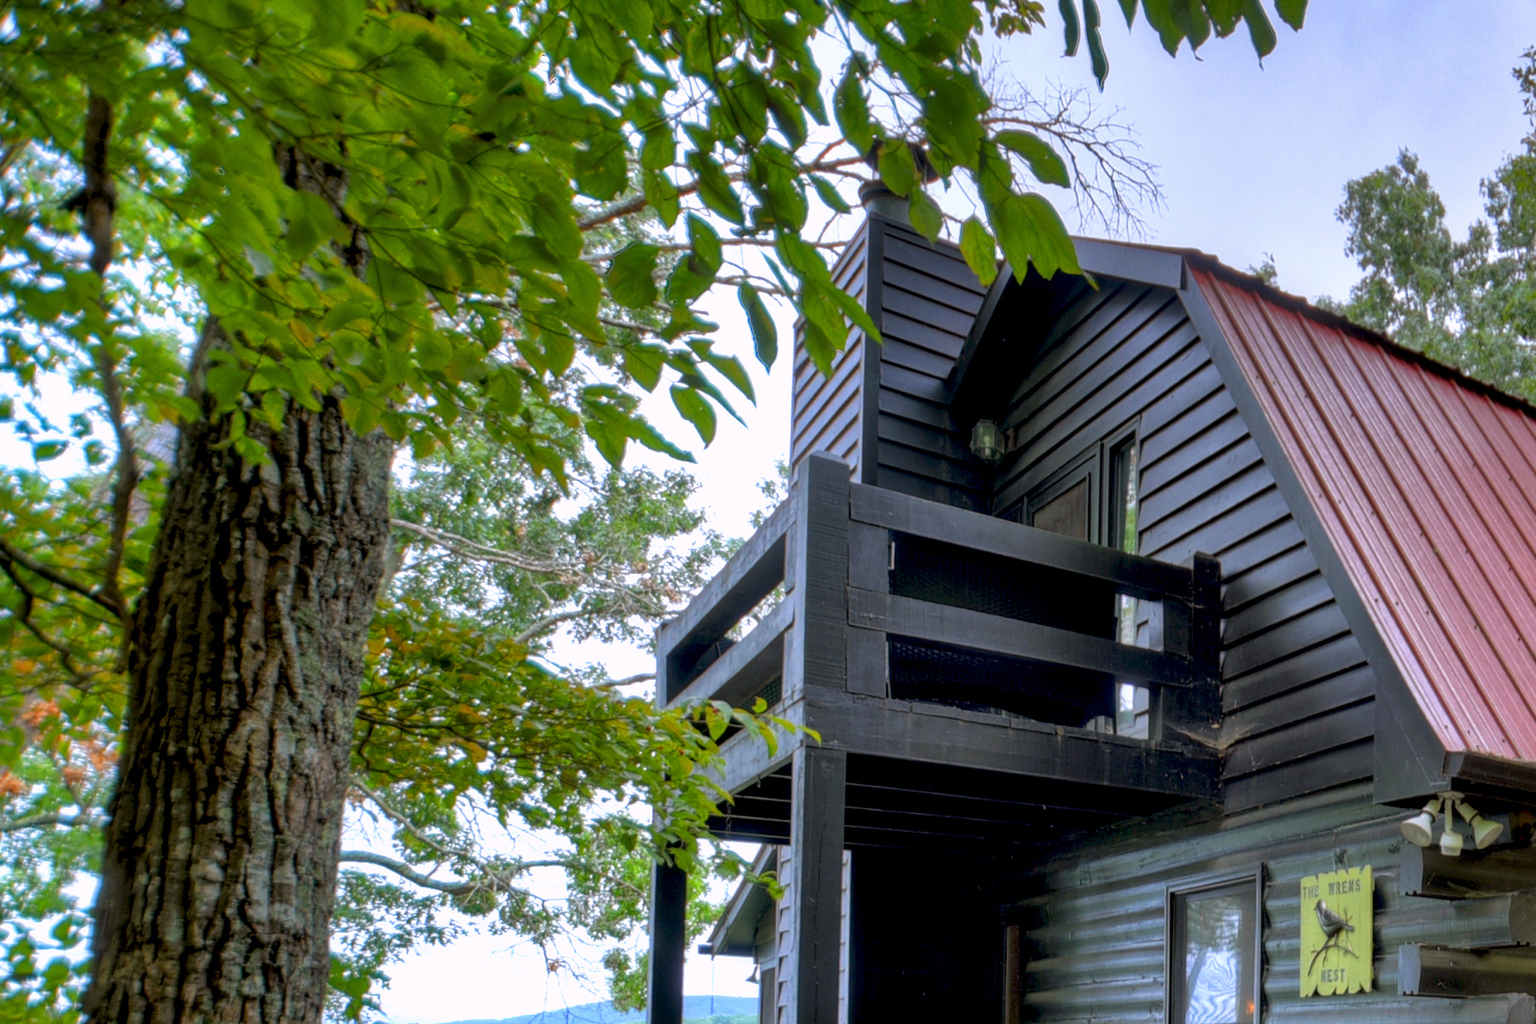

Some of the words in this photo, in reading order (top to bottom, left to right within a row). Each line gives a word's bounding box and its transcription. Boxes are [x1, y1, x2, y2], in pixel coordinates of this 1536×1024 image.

[1303, 886, 1319, 899] THE
[1328, 879, 1361, 896] WRENS
[1320, 968, 1345, 982] NEST
